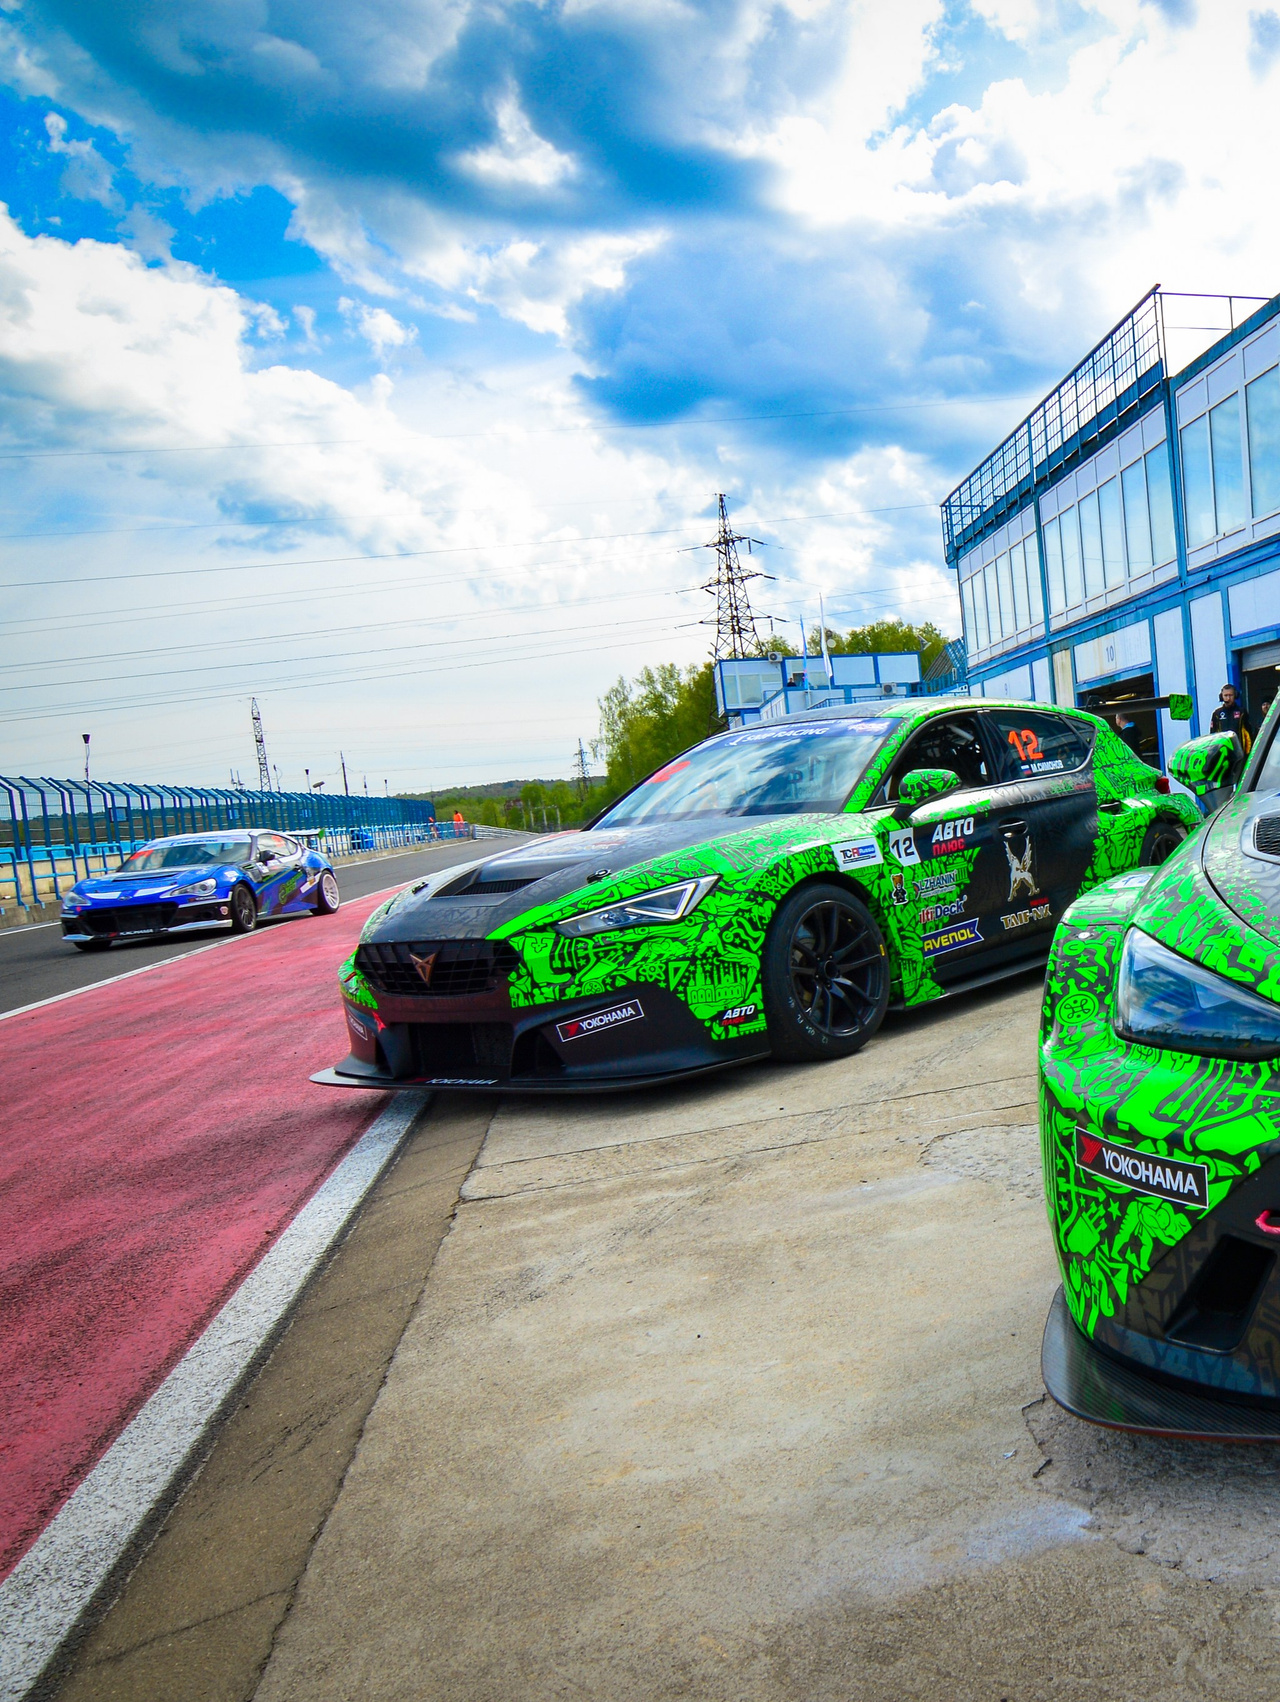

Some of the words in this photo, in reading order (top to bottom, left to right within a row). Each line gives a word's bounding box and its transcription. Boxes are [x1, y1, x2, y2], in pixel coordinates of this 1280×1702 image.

[1105, 644, 1115, 663] 10
[774, 727, 830, 739] RACING
[1008, 729, 1044, 761] 12
[932, 816, 975, 843] АВТО
[840, 847, 859, 860] TCR
[891, 836, 915, 859] 12
[932, 838, 966, 856] ПЛЮС
[579, 1006, 636, 1031] YOKOHAMA
[722, 1004, 755, 1020] АВТО
[1102, 1147, 1199, 1197] YOKOHAMA
